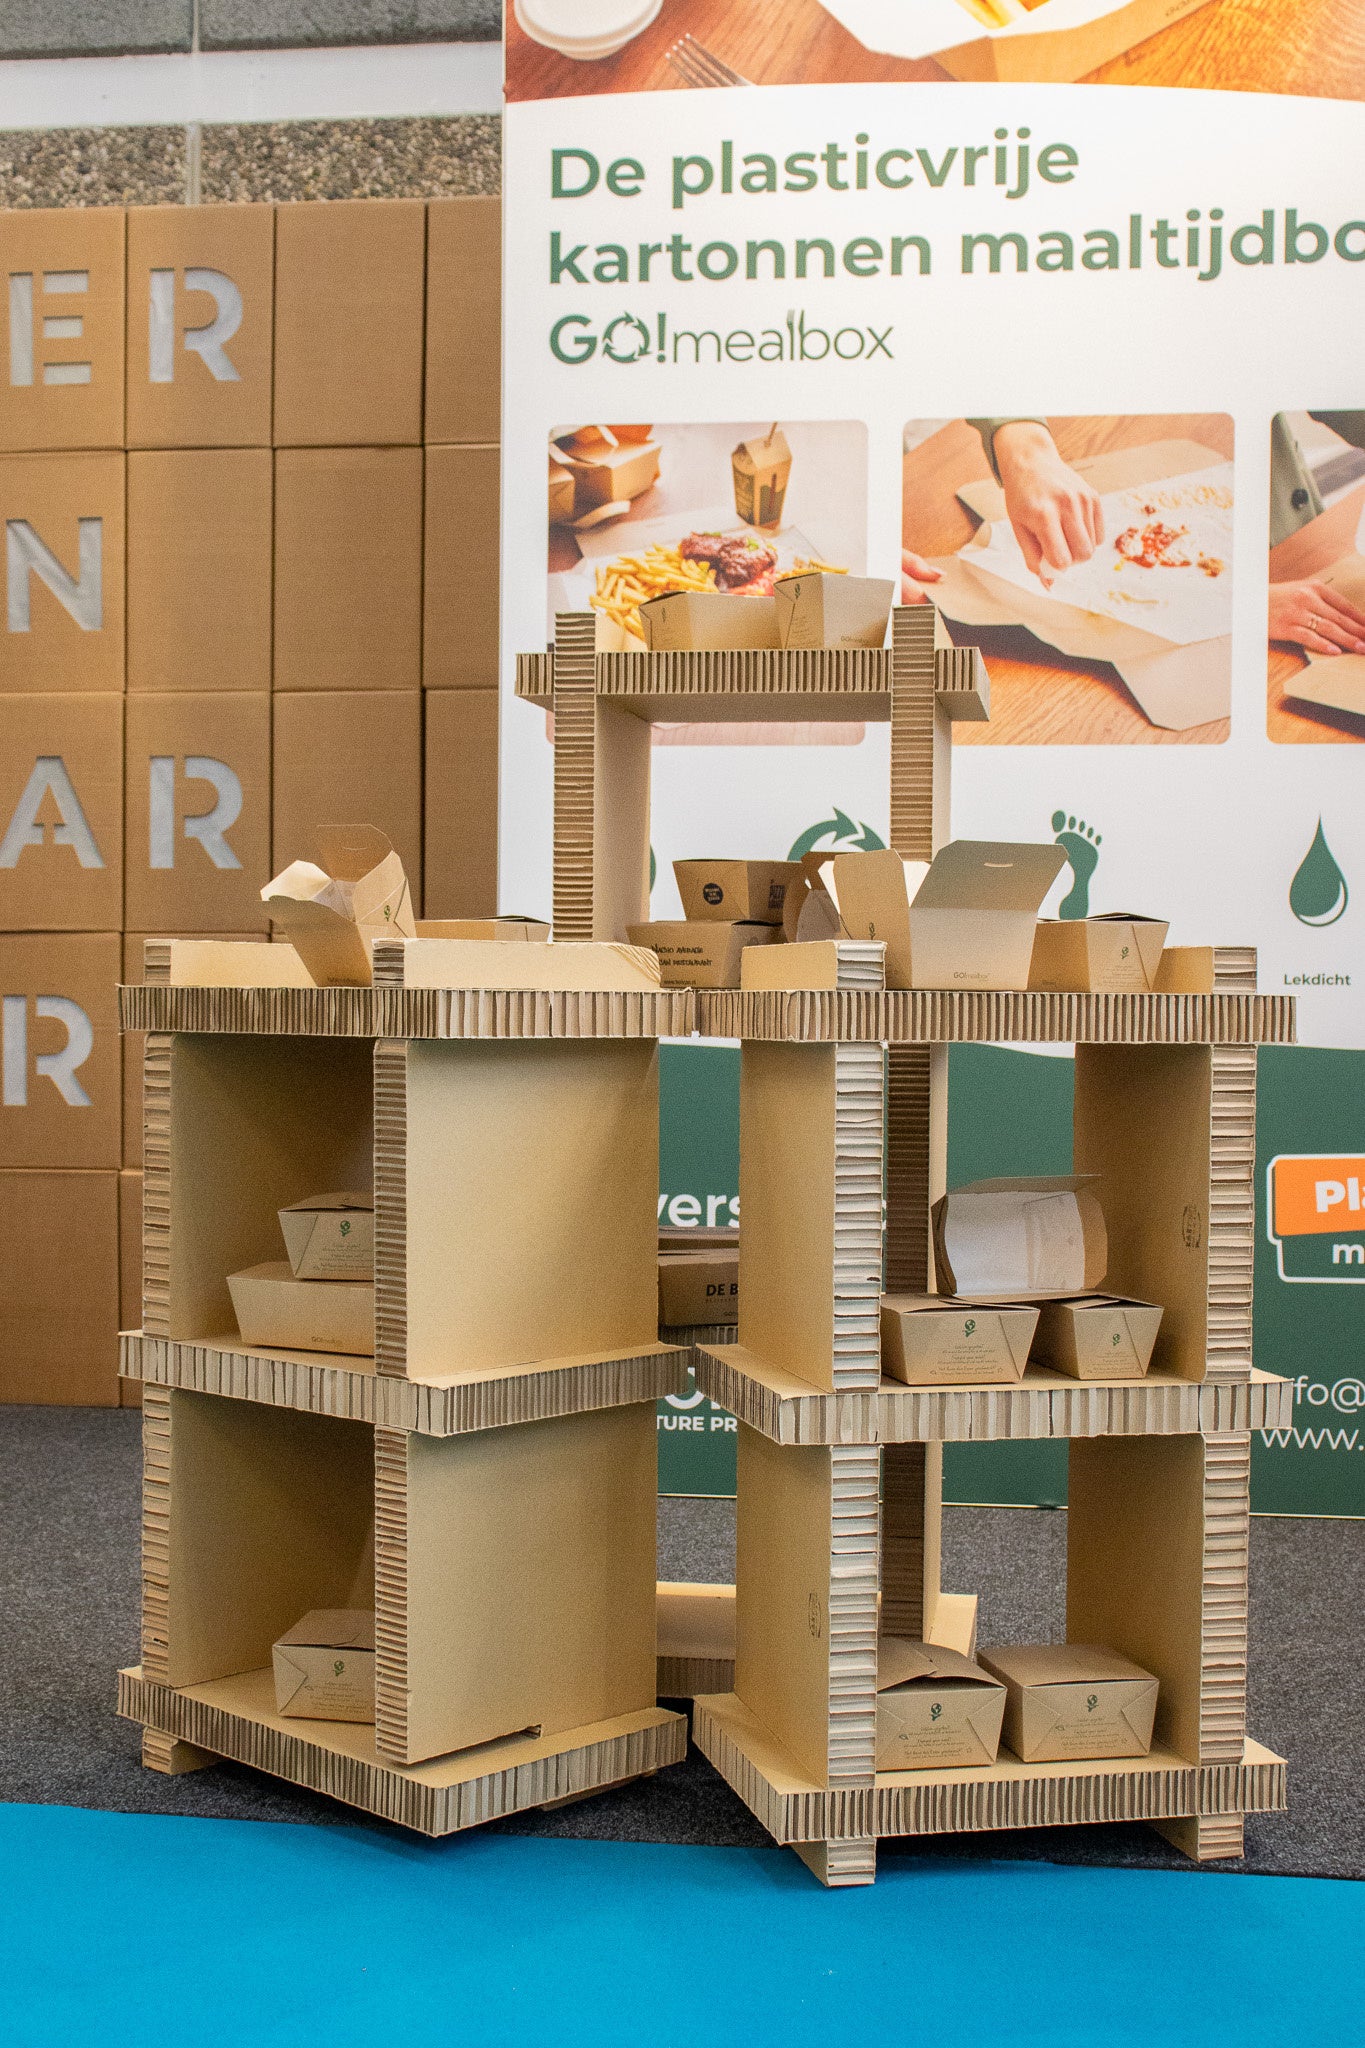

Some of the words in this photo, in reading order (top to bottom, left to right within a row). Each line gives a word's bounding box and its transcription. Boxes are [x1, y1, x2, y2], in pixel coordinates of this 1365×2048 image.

[550, 147, 646, 199] De
[671, 127, 1079, 210] plasticvrije
[549, 230, 932, 284] kartonnen
[960, 208, 1365, 281] maaltijdbo
[1283, 973, 1352, 987] Lekdicht
[1315, 1177, 1365, 1213] Pl
[706, 1284, 726, 1297] DE
